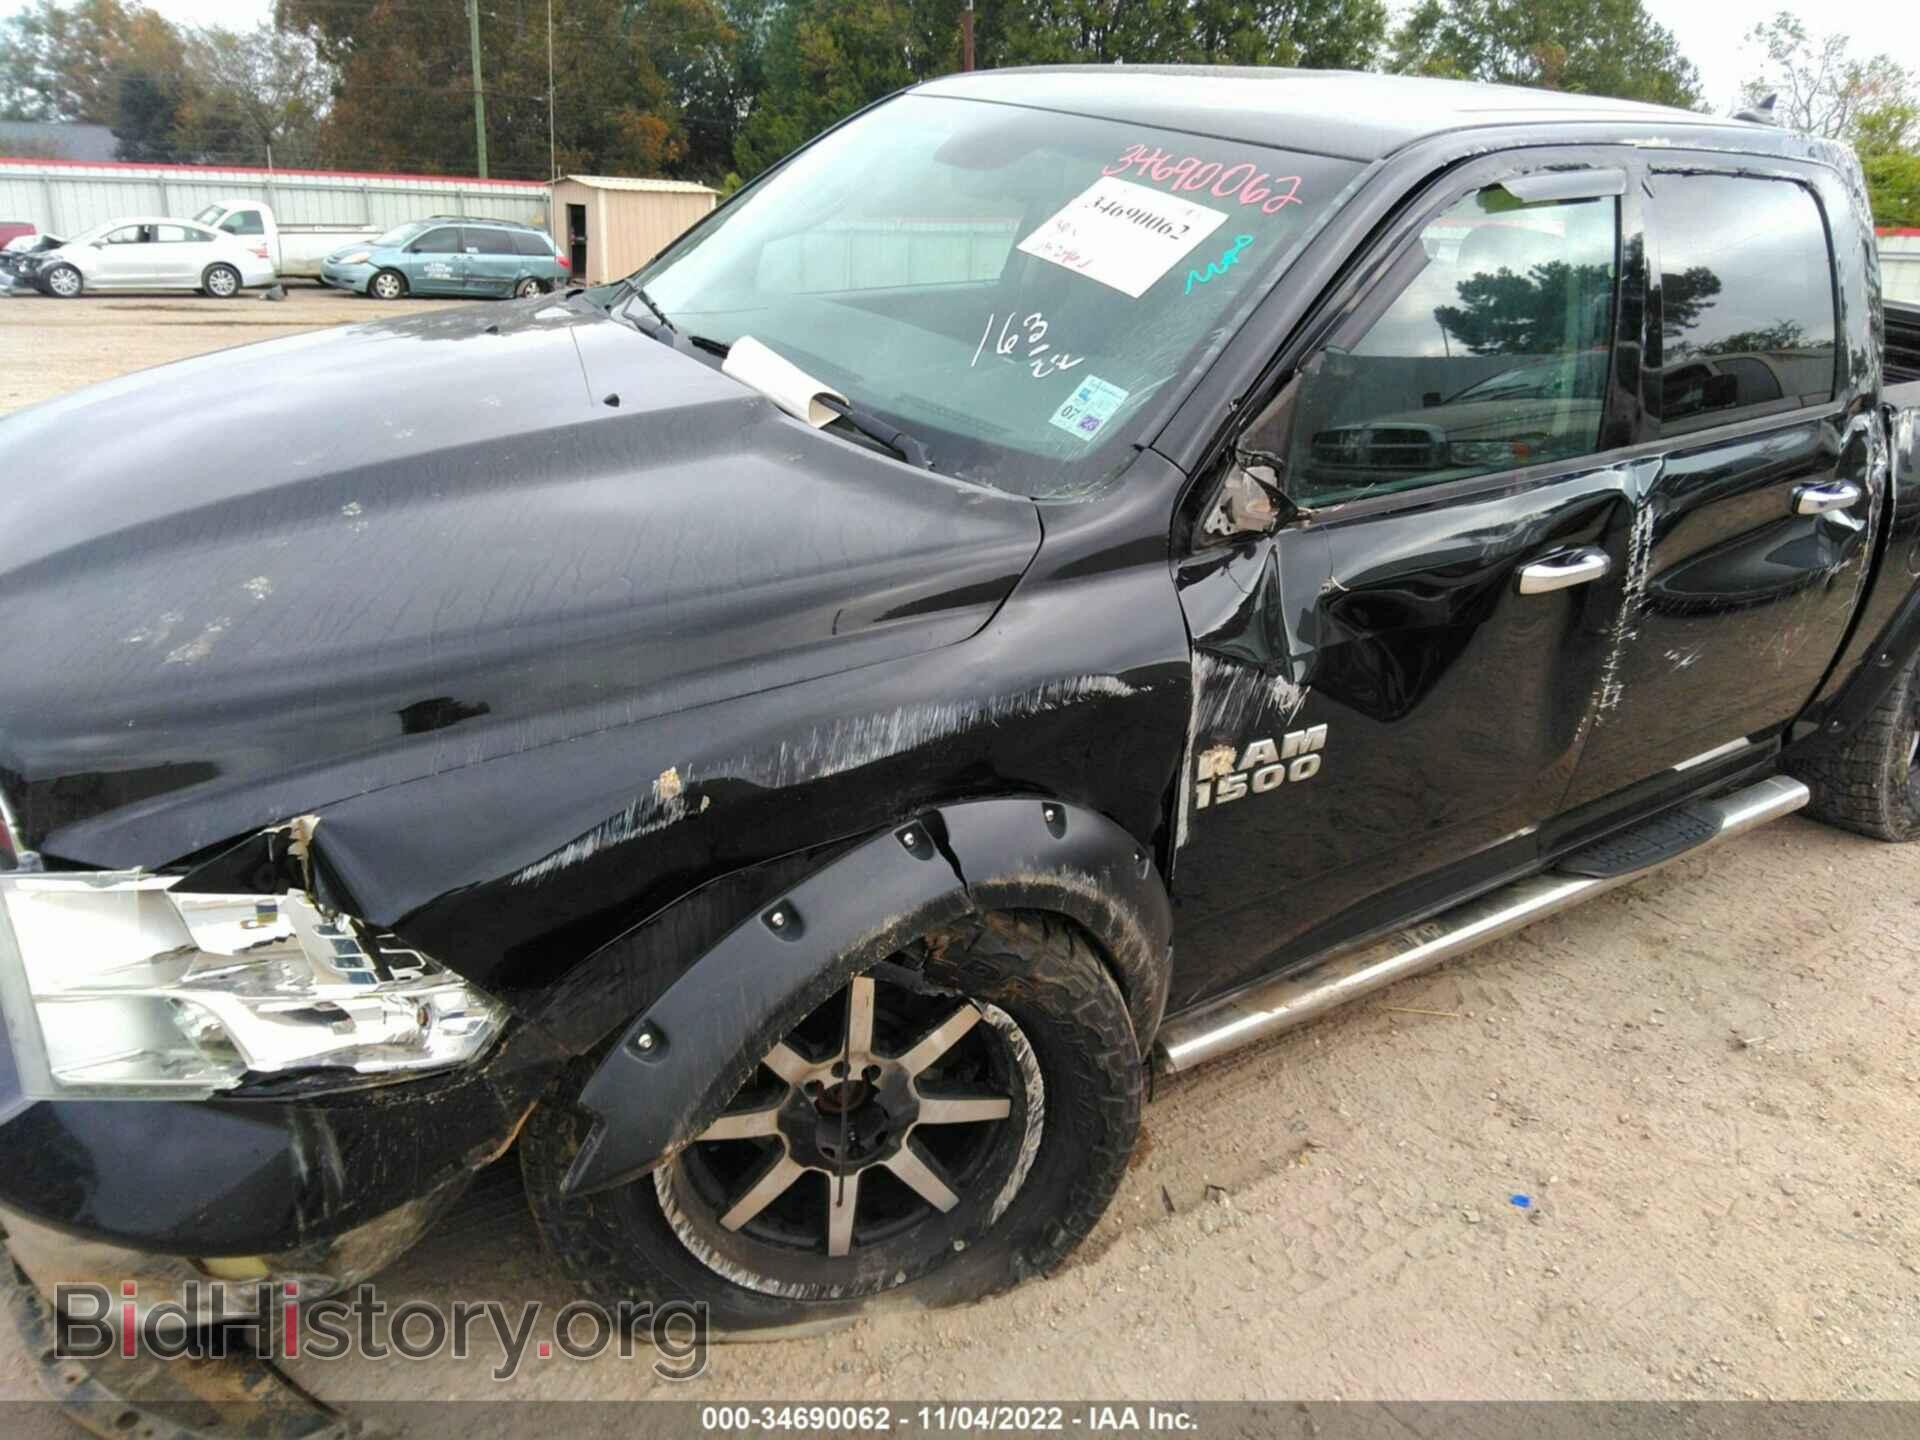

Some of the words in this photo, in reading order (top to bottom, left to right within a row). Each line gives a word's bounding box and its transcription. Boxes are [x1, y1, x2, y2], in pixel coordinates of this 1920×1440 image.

[1101, 143, 1303, 214] 34690062
[1061, 405, 1081, 420] 07
[1196, 722, 1329, 782] RAM
[1195, 753, 1322, 810] 1500
